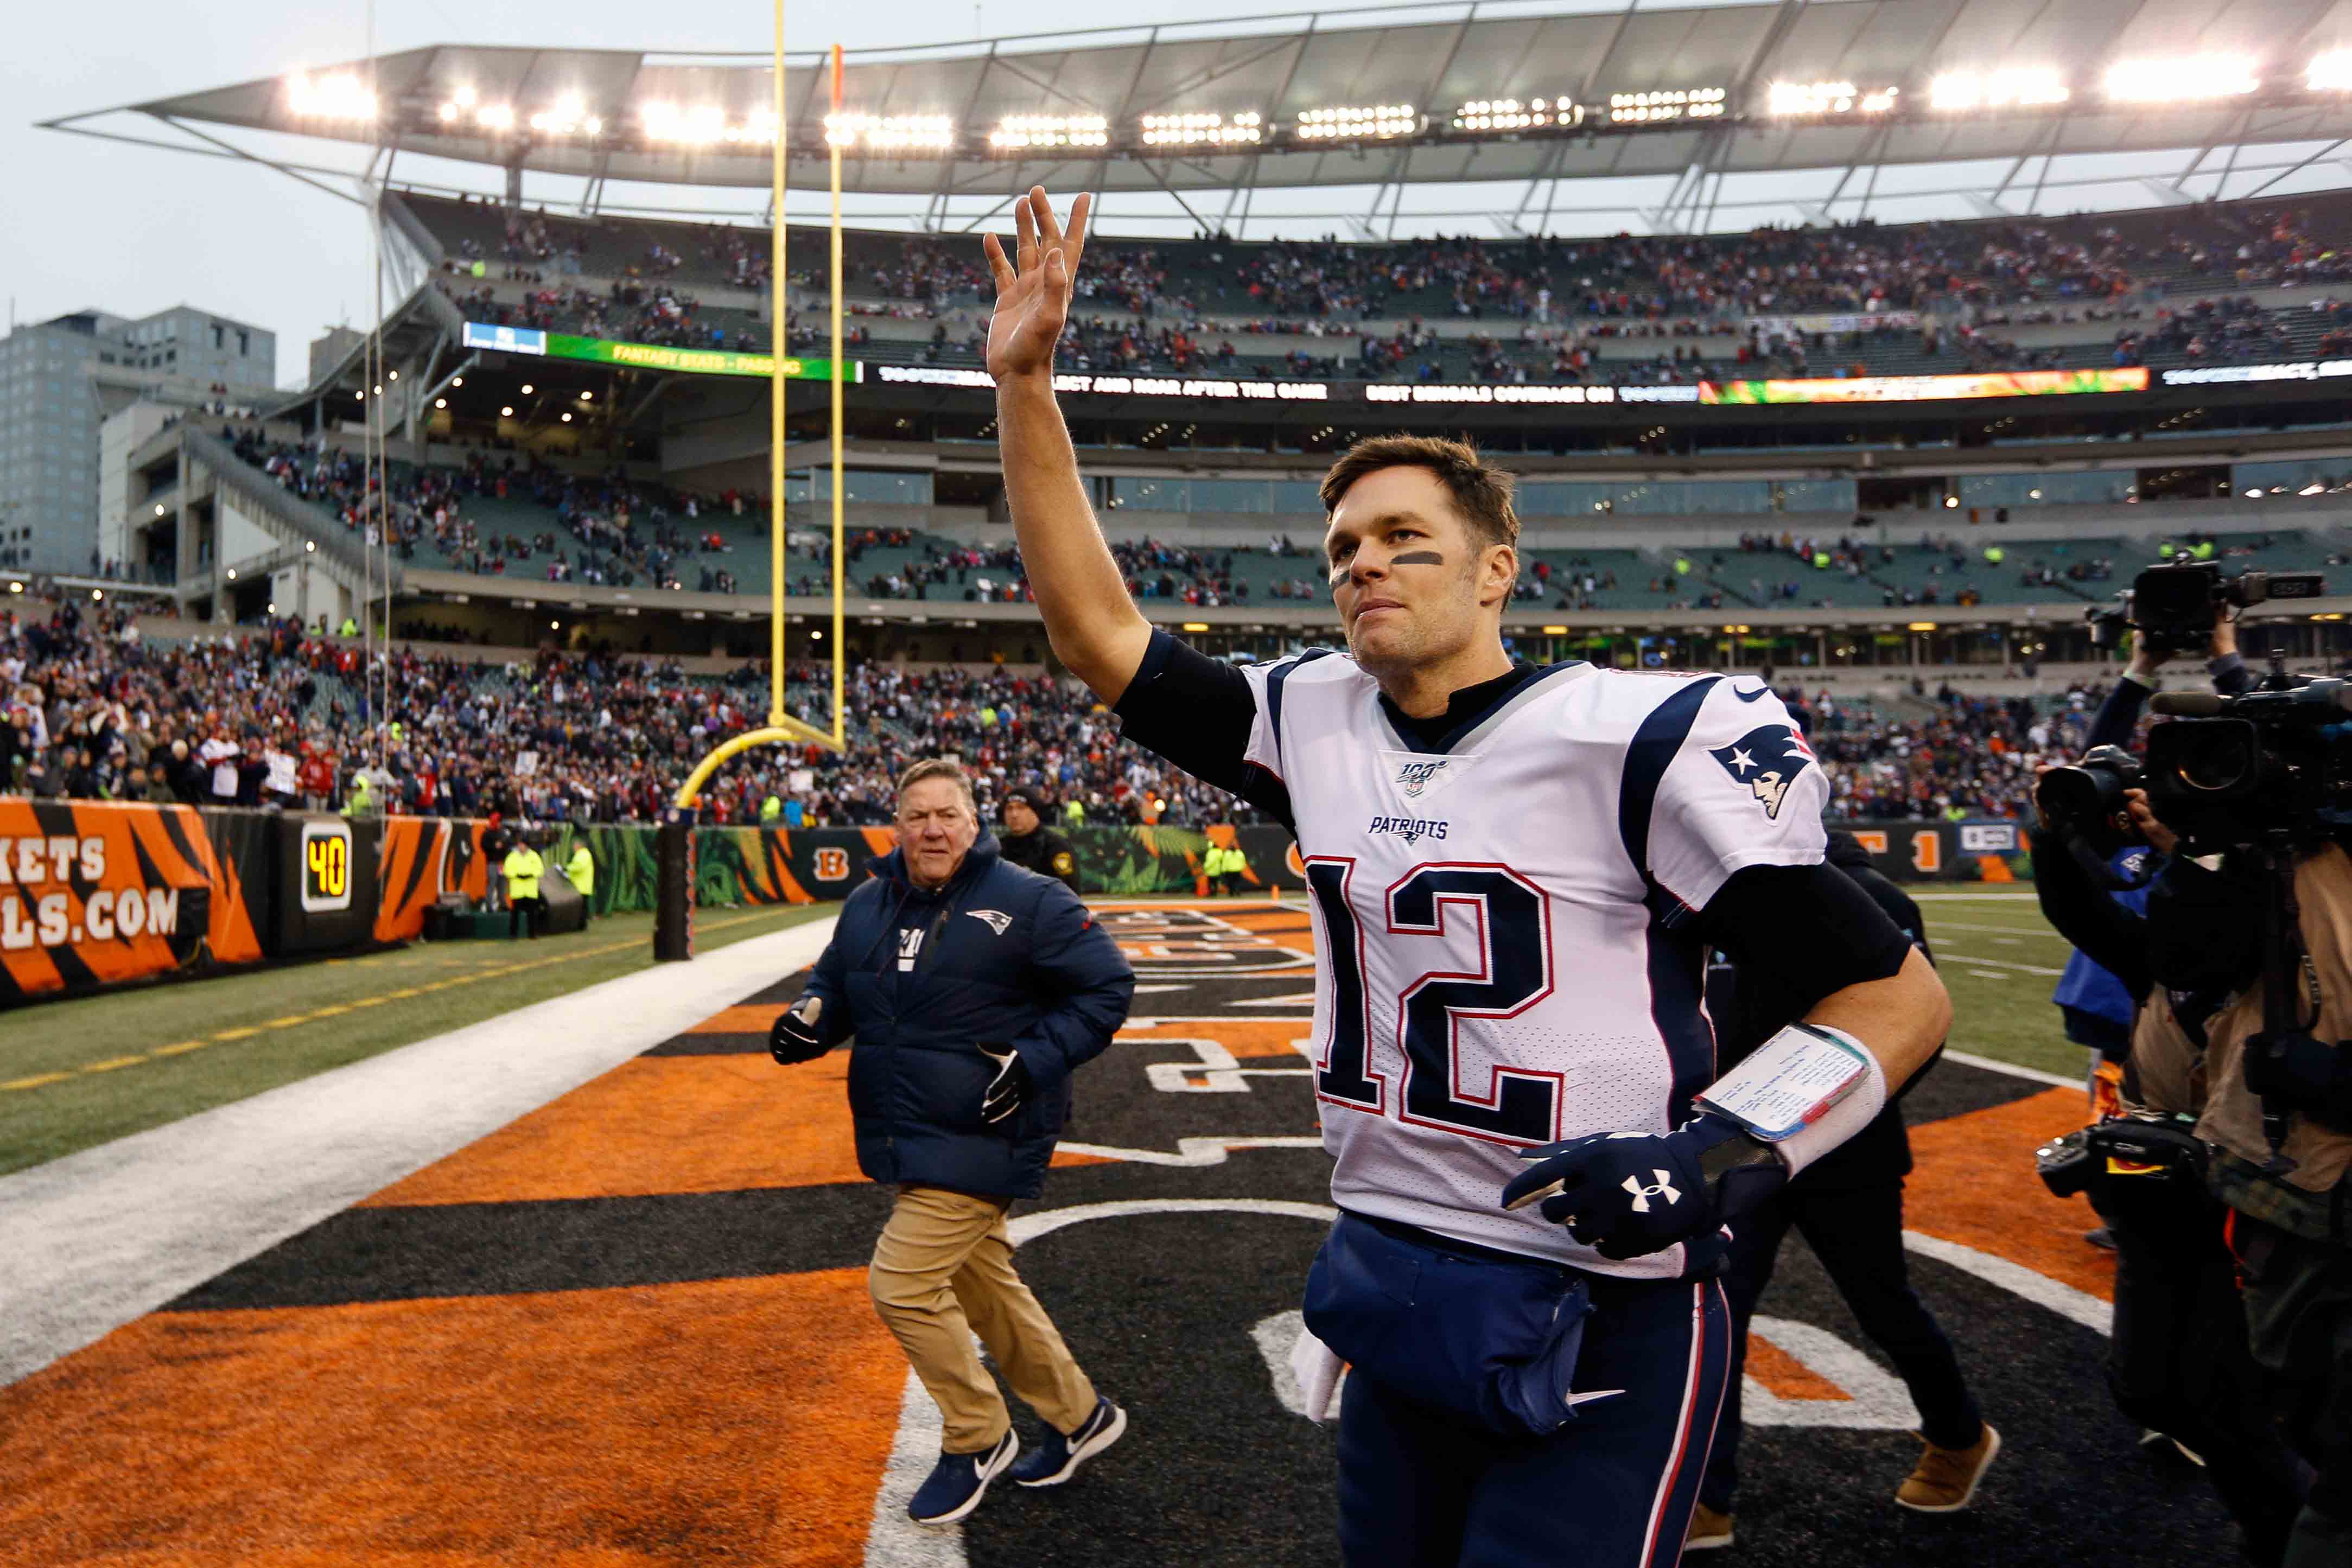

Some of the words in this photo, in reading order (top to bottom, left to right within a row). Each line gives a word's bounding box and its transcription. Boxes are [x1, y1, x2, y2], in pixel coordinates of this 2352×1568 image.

[613, 345, 678, 364] FANTASY
[679, 353, 725, 369] STATS
[736, 356, 801, 374] PASSG
[1183, 380, 1239, 397] AFTER
[1239, 382, 1276, 398] THE
[1368, 816, 1449, 840] PATRIOTS
[309, 836, 346, 896] 40
[1302, 855, 1565, 1149] 12
